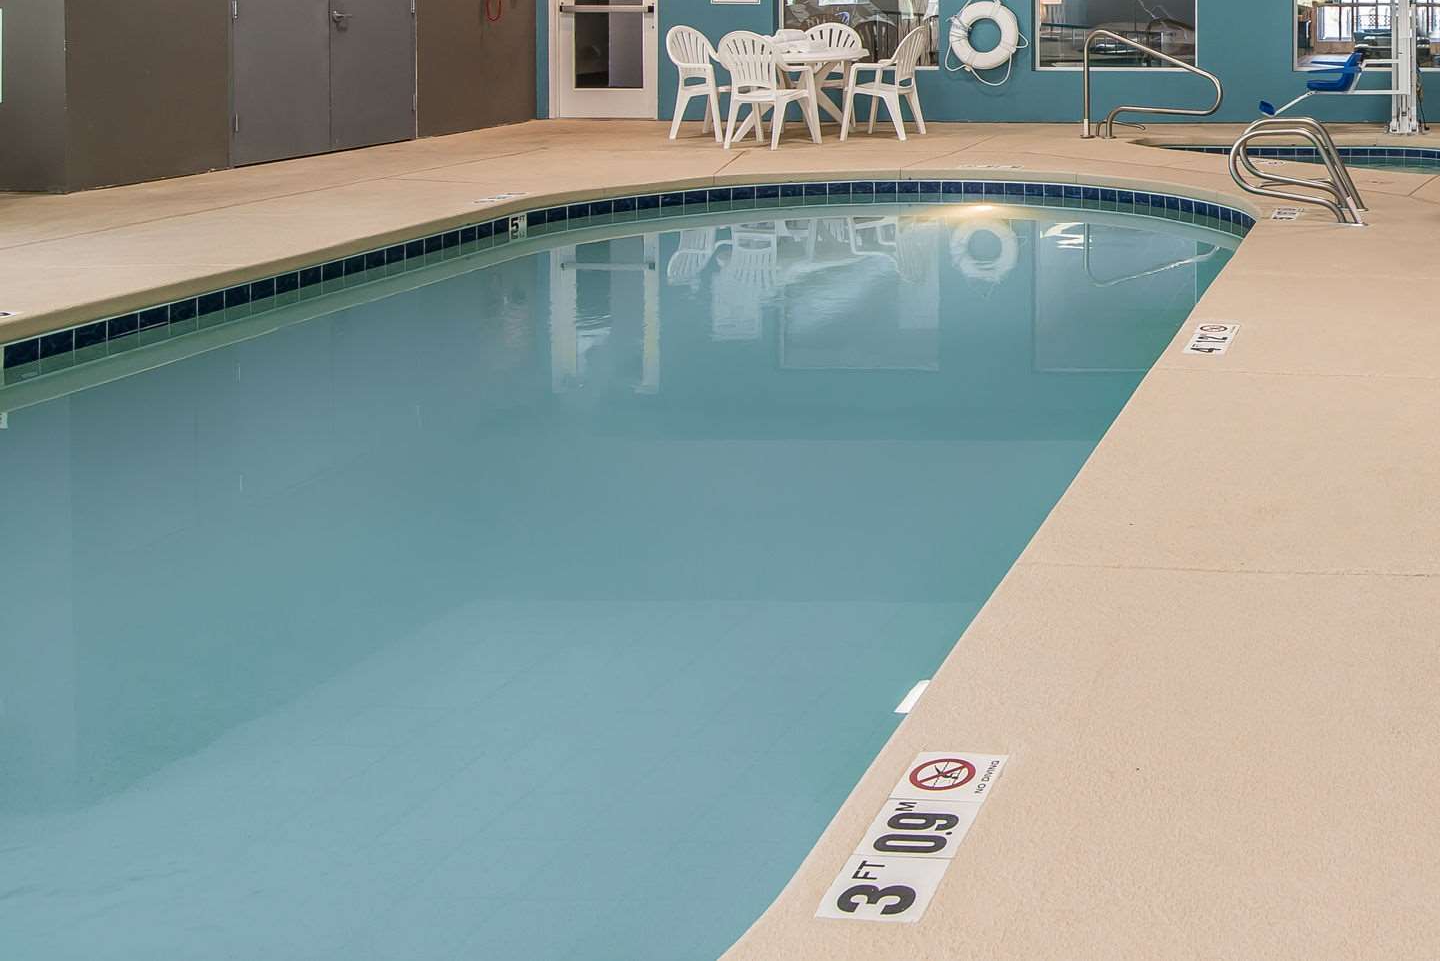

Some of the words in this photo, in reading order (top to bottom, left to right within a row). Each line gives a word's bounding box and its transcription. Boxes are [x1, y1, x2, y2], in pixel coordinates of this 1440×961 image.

[511, 216, 520, 234] 5
[980, 760, 1000, 782] DIVING
[974, 782, 987, 795] NO
[895, 801, 918, 812] M
[873, 812, 960, 854] 0.9
[851, 860, 886, 881] FT
[836, 884, 917, 916] 3
